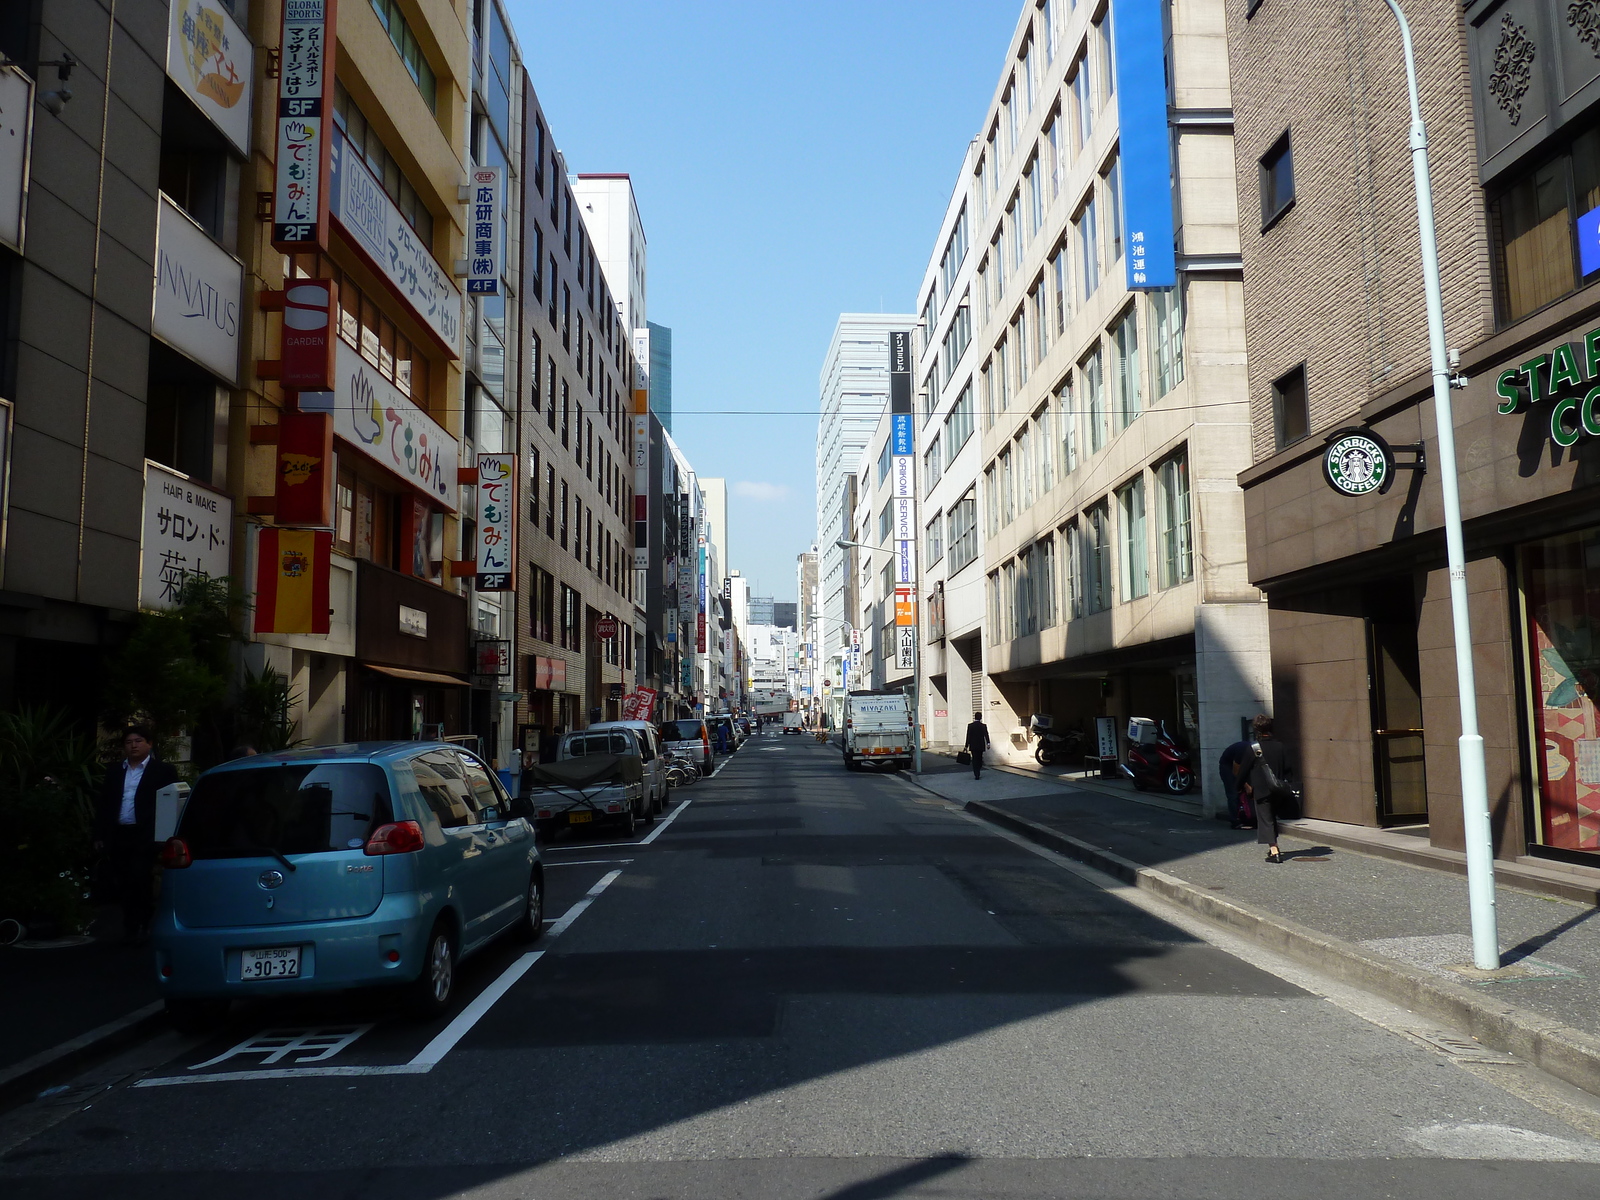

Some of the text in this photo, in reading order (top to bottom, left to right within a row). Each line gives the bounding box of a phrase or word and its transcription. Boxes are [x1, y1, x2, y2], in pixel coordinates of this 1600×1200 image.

[287, 1, 322, 10] GLOBAL
[287, 10, 321, 18] SPORTS
[286, 28, 304, 95] マッサージ・はり
[306, 27, 320, 87] グローバルスポーツ
[288, 100, 315, 116] 5F
[287, 144, 306, 220] てもみん
[350, 163, 384, 223] GLOBAL
[284, 225, 310, 240] 2F
[350, 192, 383, 247] SPORTS
[472, 186, 493, 275] 応研商事(株)
[398, 223, 450, 301] グローバルスポーツ
[1131, 231, 1147, 283] 鴻池運輸
[158, 249, 236, 338] INNATUS
[388, 238, 457, 343] マッサージ・はり
[472, 281, 492, 291] 4F
[287, 337, 324, 346] GARDEN
[896, 333, 904, 371] オリコミビル
[386, 407, 446, 495] てもみん
[897, 416, 906, 452] 琉球新報社
[1330, 438, 1383, 464] STARBUCKS
[163, 481, 217, 513] HAIR & MAKE
[899, 458, 908, 538] ORIKOMI SERVICE
[1337, 476, 1378, 492] COFFEE
[481, 483, 504, 567] てもみん
[484, 574, 505, 588] 2F
[901, 628, 913, 667] 大山歯科
[347, 865, 373, 874] Porte
[254, 959, 297, 977] 90-32
[256, 949, 288, 960] 山形 500
[187, 1023, 376, 1071] 用
